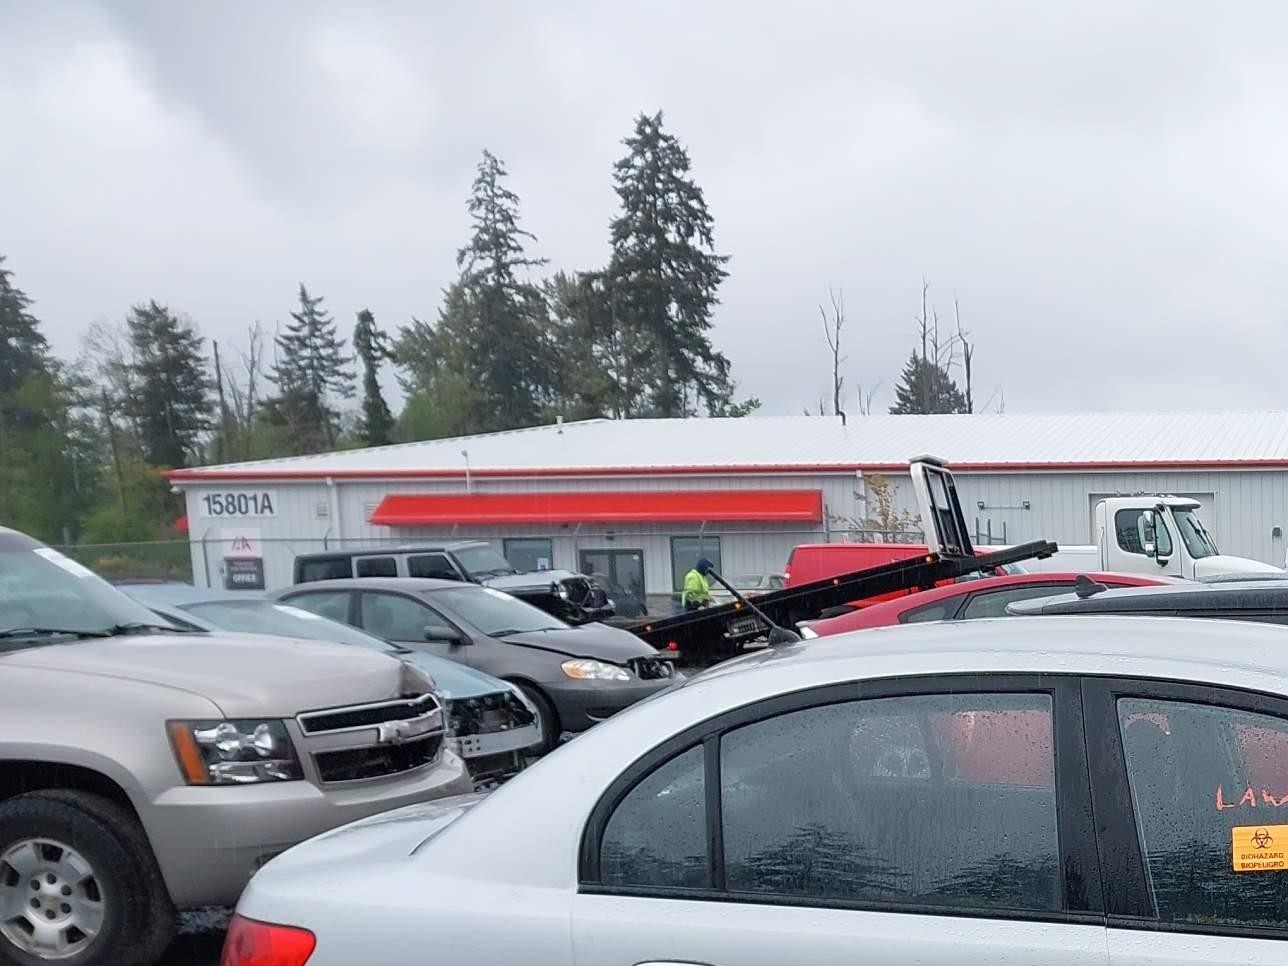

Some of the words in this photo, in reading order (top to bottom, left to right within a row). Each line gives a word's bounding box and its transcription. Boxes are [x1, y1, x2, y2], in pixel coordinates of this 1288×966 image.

[202, 493, 274, 516] 15801A
[1240, 852, 1284, 860] BIOHAZARD
[1240, 860, 1285, 869] BIOPELIGRO
